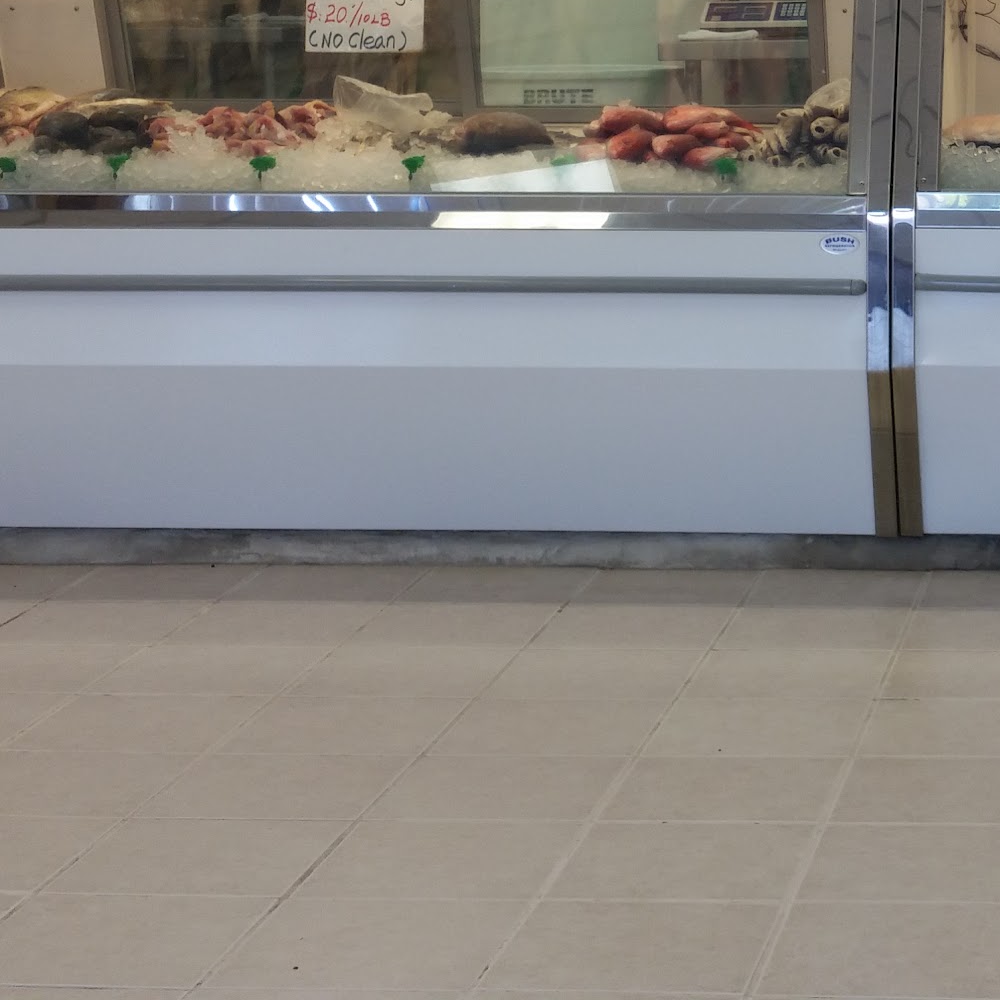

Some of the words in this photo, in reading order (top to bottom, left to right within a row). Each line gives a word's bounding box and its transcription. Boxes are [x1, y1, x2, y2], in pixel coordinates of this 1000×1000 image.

[308, 30, 344, 49] (NO
[348, 28, 407, 51] Clean)
[523, 88, 594, 105] BRUTE
[825, 236, 855, 245] BUSH
